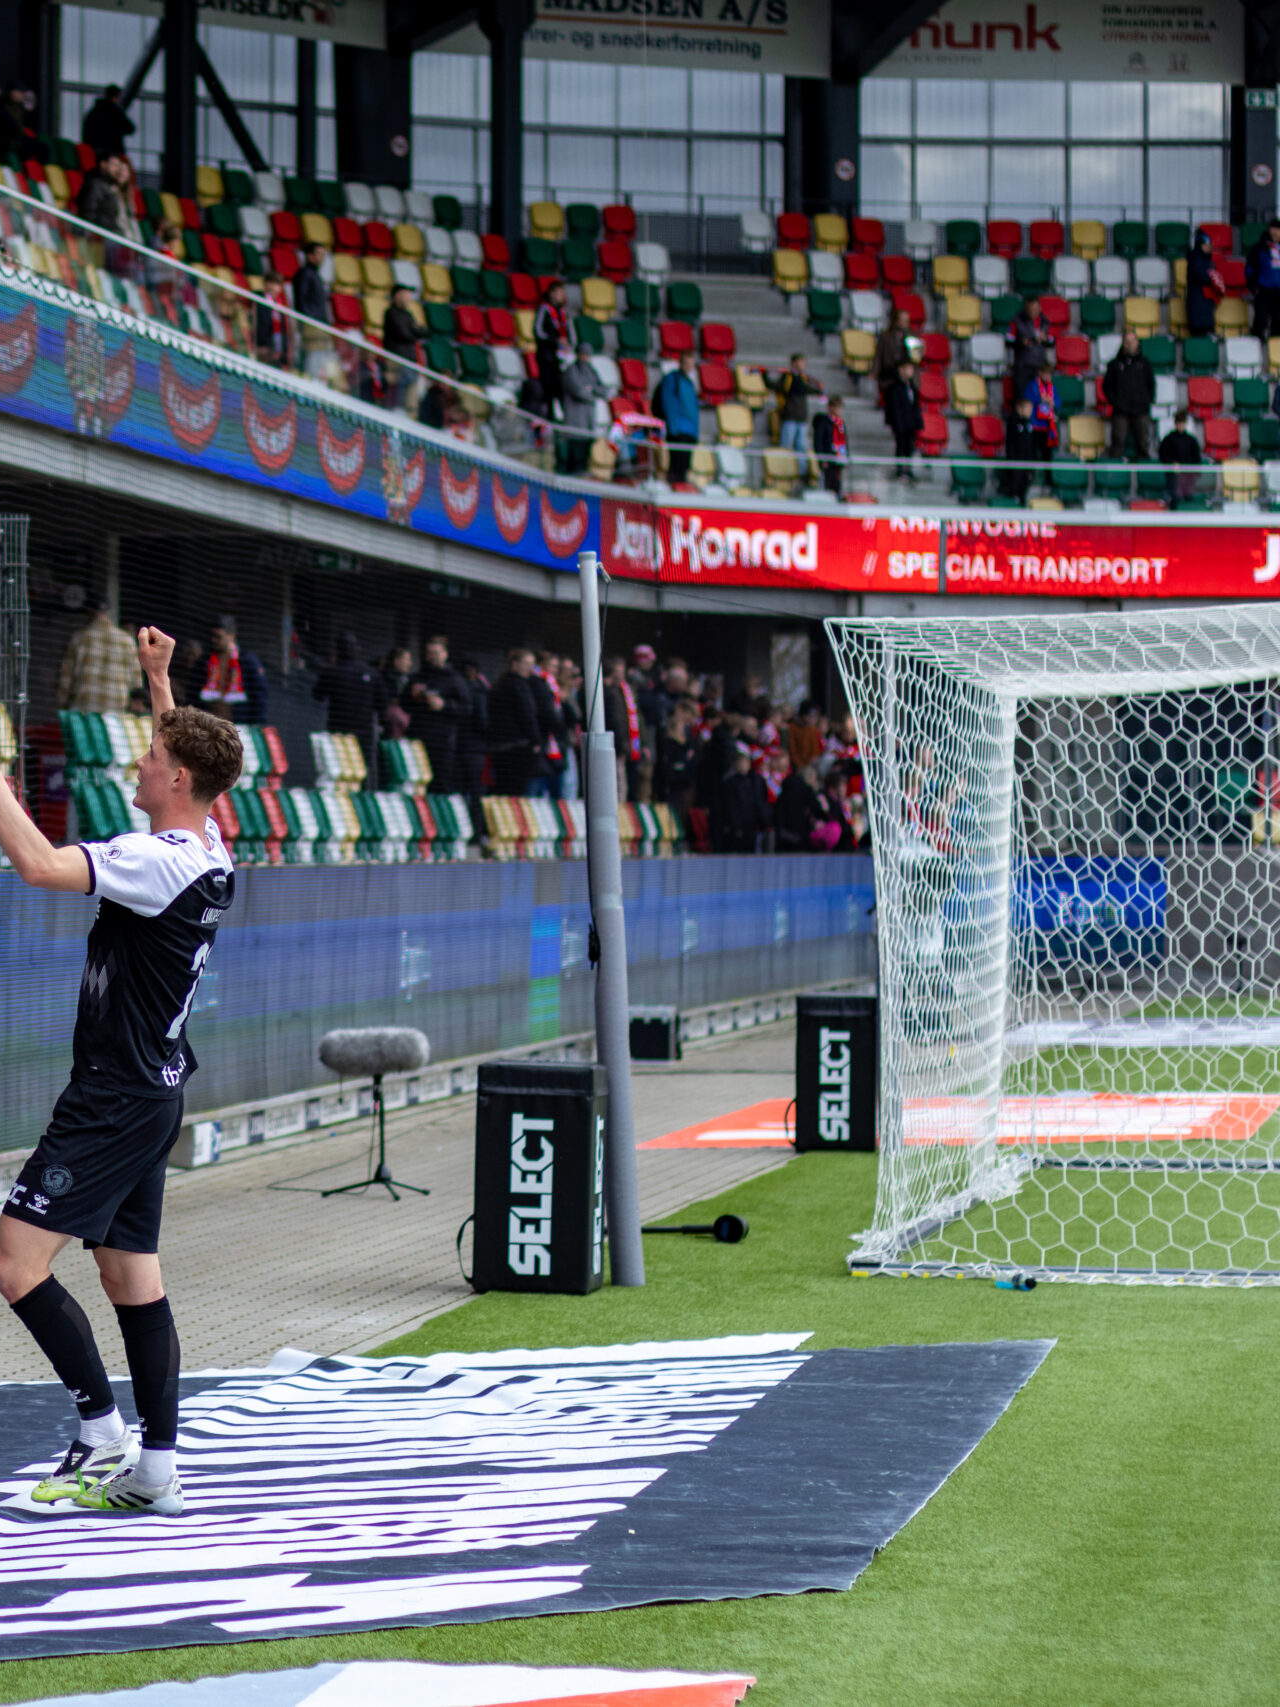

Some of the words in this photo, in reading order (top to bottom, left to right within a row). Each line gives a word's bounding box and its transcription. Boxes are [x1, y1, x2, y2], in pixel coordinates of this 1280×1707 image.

[887, 550, 1004, 582] SPECIAL
[1007, 553, 1169, 584] TRANSPORT
[817, 1026, 851, 1141] SELECT
[507, 1112, 555, 1277] SELECT
